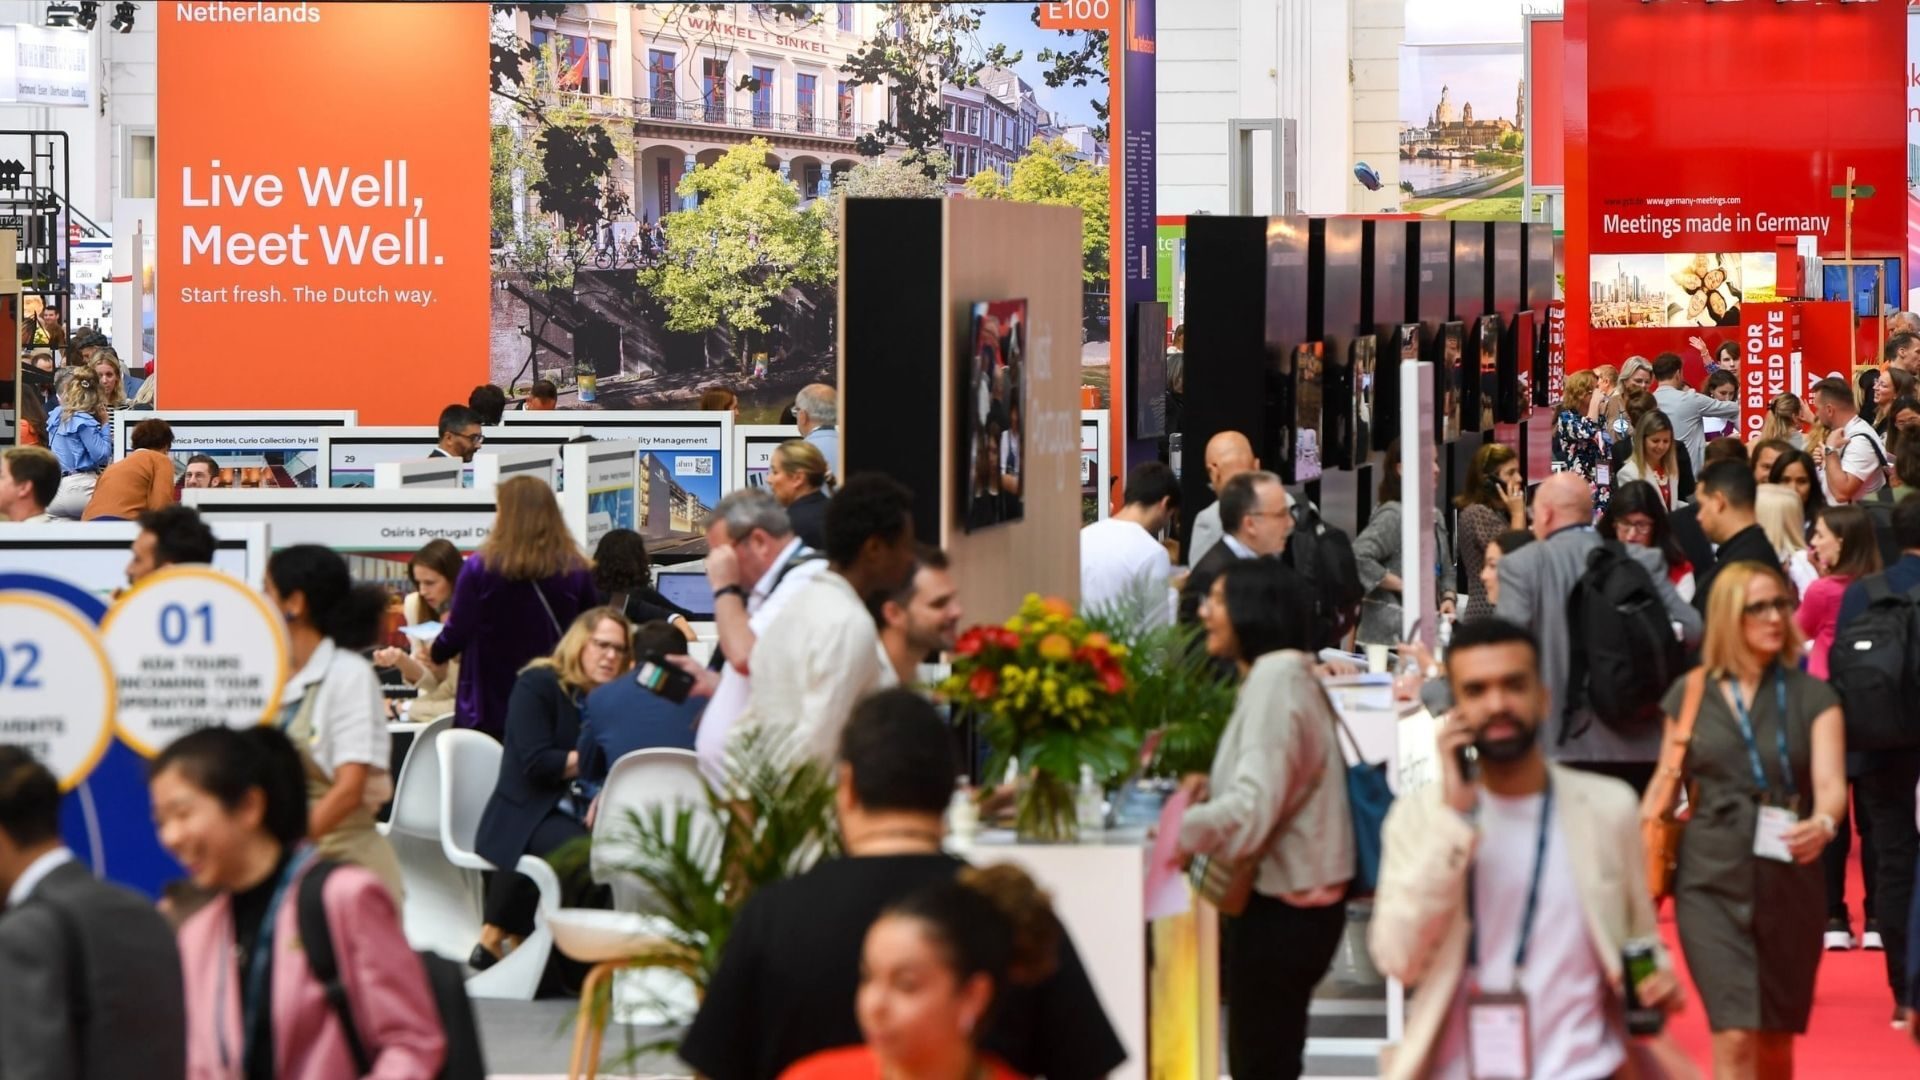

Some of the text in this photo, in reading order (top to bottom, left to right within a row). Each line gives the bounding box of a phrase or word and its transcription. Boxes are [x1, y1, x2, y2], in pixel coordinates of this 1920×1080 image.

[176, 2, 321, 23] Netherlands
[1049, 0, 1109, 20] E100
[687, 17, 757, 40] WINKEL
[775, 35, 830, 54] SINKEL
[182, 159, 424, 218] Live Well,
[1646, 195, 1741, 207] www.germany-meetings.com
[1603, 211, 1831, 239] Meetings made in Germany
[182, 217, 445, 266] Meet Well.
[180, 284, 437, 307] Start fresh. The Dutch way.
[1767, 310, 1784, 348] EYE
[1747, 323, 1764, 365] FOR
[1747, 370, 1764, 408] BIG
[194, 436, 214, 445] Porto
[216, 436, 237, 446] Hotel,
[238, 436, 259, 445] Curio
[260, 436, 296, 445] Collection
[298, 436, 307, 447] by
[653, 436, 708, 447] Management
[344, 455, 356, 463] 29
[380, 527, 416, 538] Osiris
[419, 527, 472, 539] Portugal
[159, 602, 215, 647] 01
